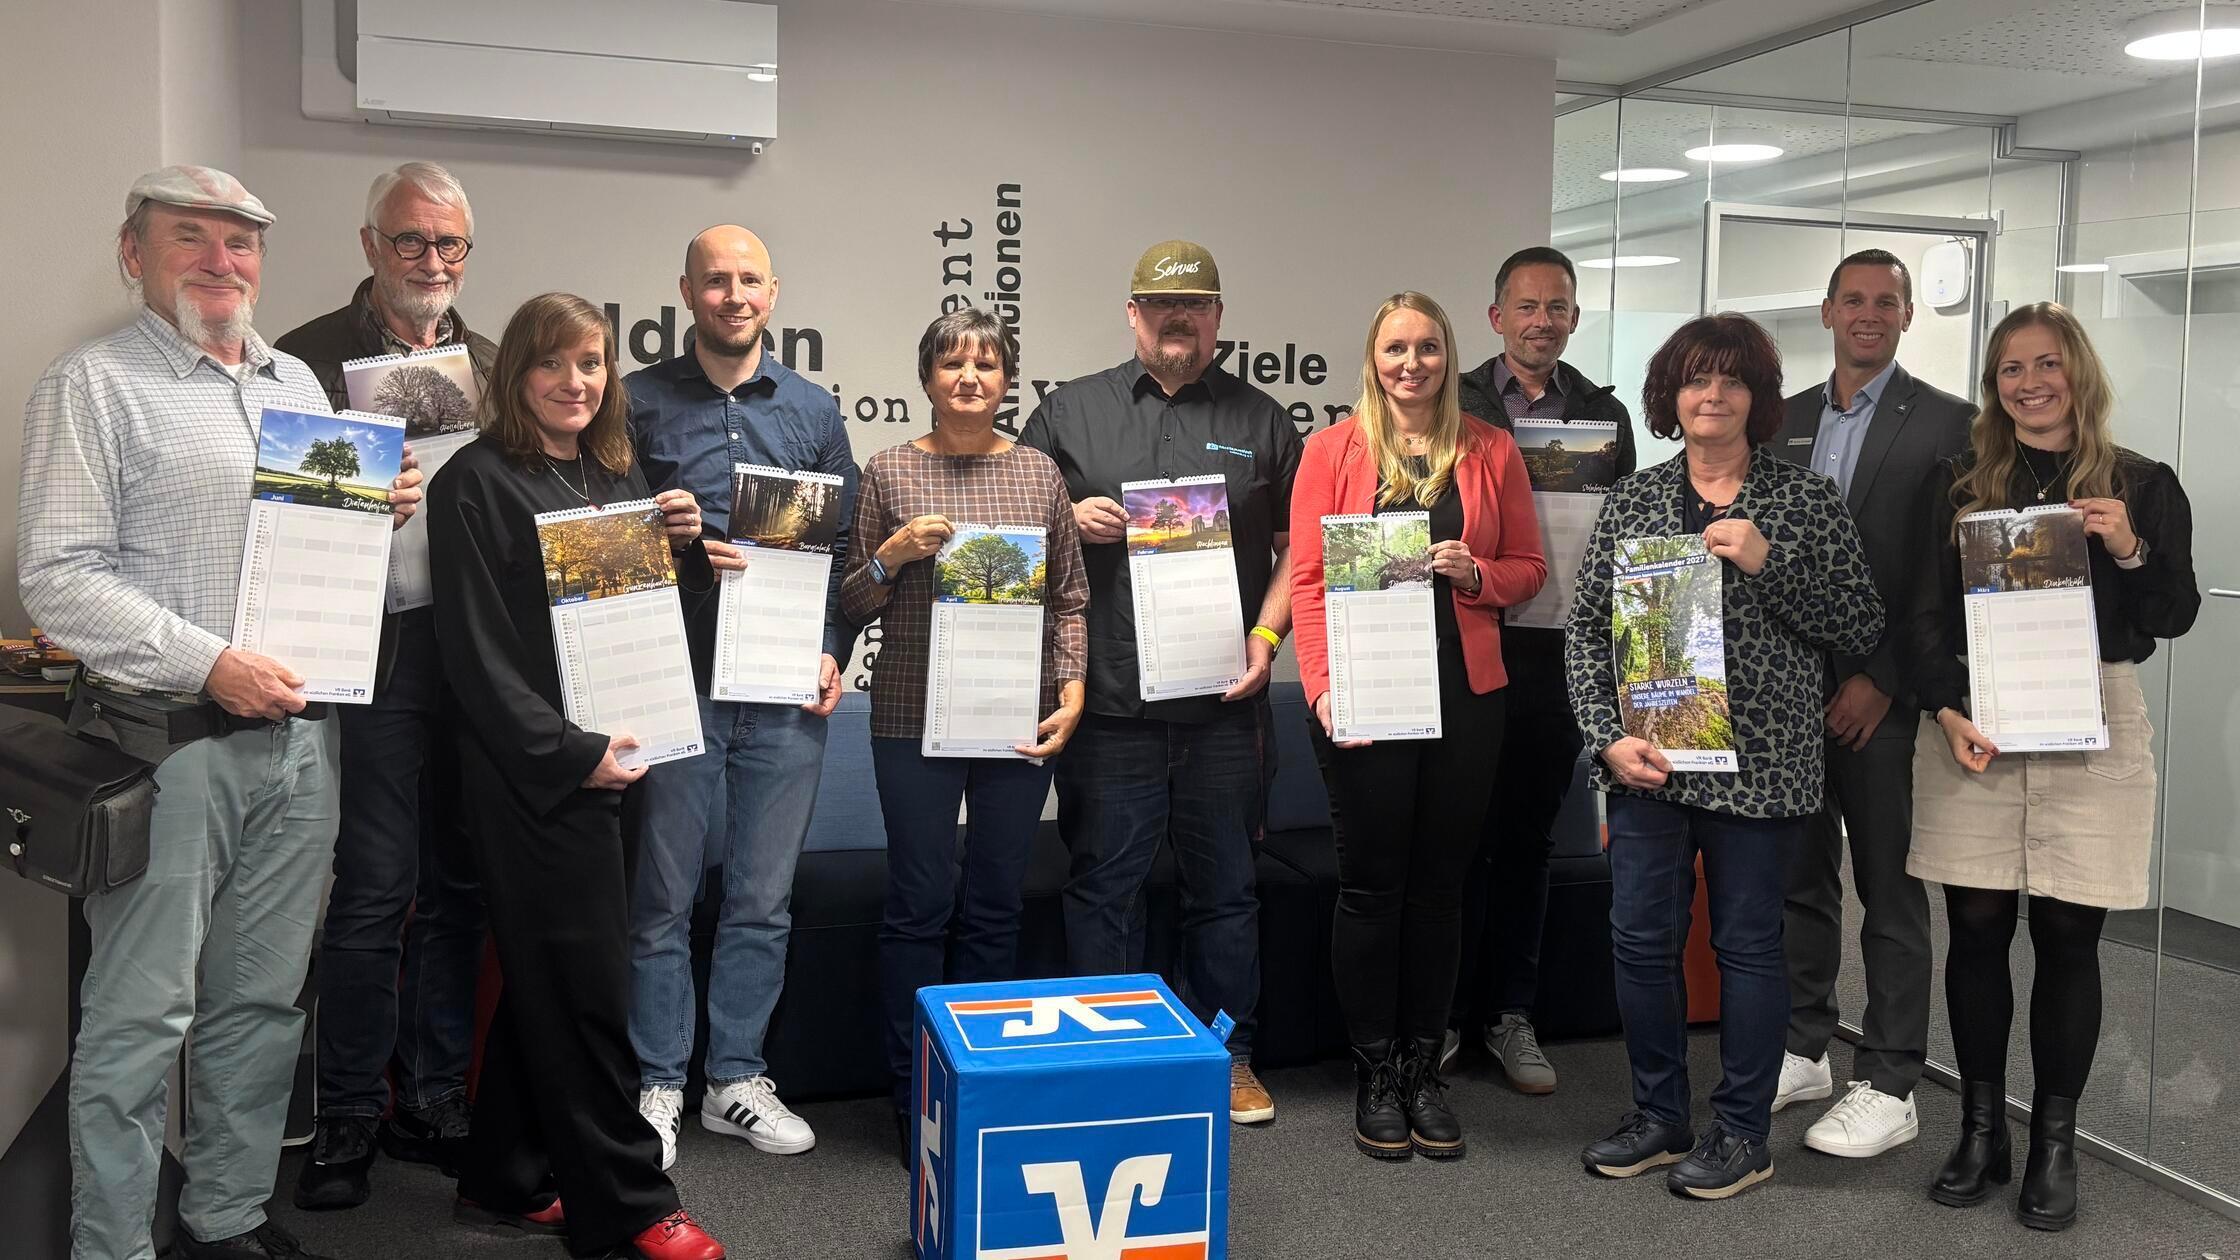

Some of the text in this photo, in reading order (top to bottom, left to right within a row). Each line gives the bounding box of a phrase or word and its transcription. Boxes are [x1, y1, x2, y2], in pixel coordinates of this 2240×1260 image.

[1152, 256, 1202, 281] Servus
[1214, 340, 1328, 386] Ziele
[270, 493, 285, 501] Juni
[341, 497, 392, 516] Dietenhofen
[731, 538, 756, 546] November
[1625, 555, 1705, 573] Familienkalender 2027
[2043, 575, 2085, 589] Dinkelsbühl
[560, 595, 584, 604] Oktober
[1629, 682, 1655, 692] STARKE
[1655, 678, 1688, 689] WURZELN
[1631, 692, 1650, 700] UNSERE
[1650, 690, 1668, 699] BÄUME
[1676, 688, 1696, 697] WANDEL
[1633, 698, 1679, 709] DER JAHRESZEITEN
